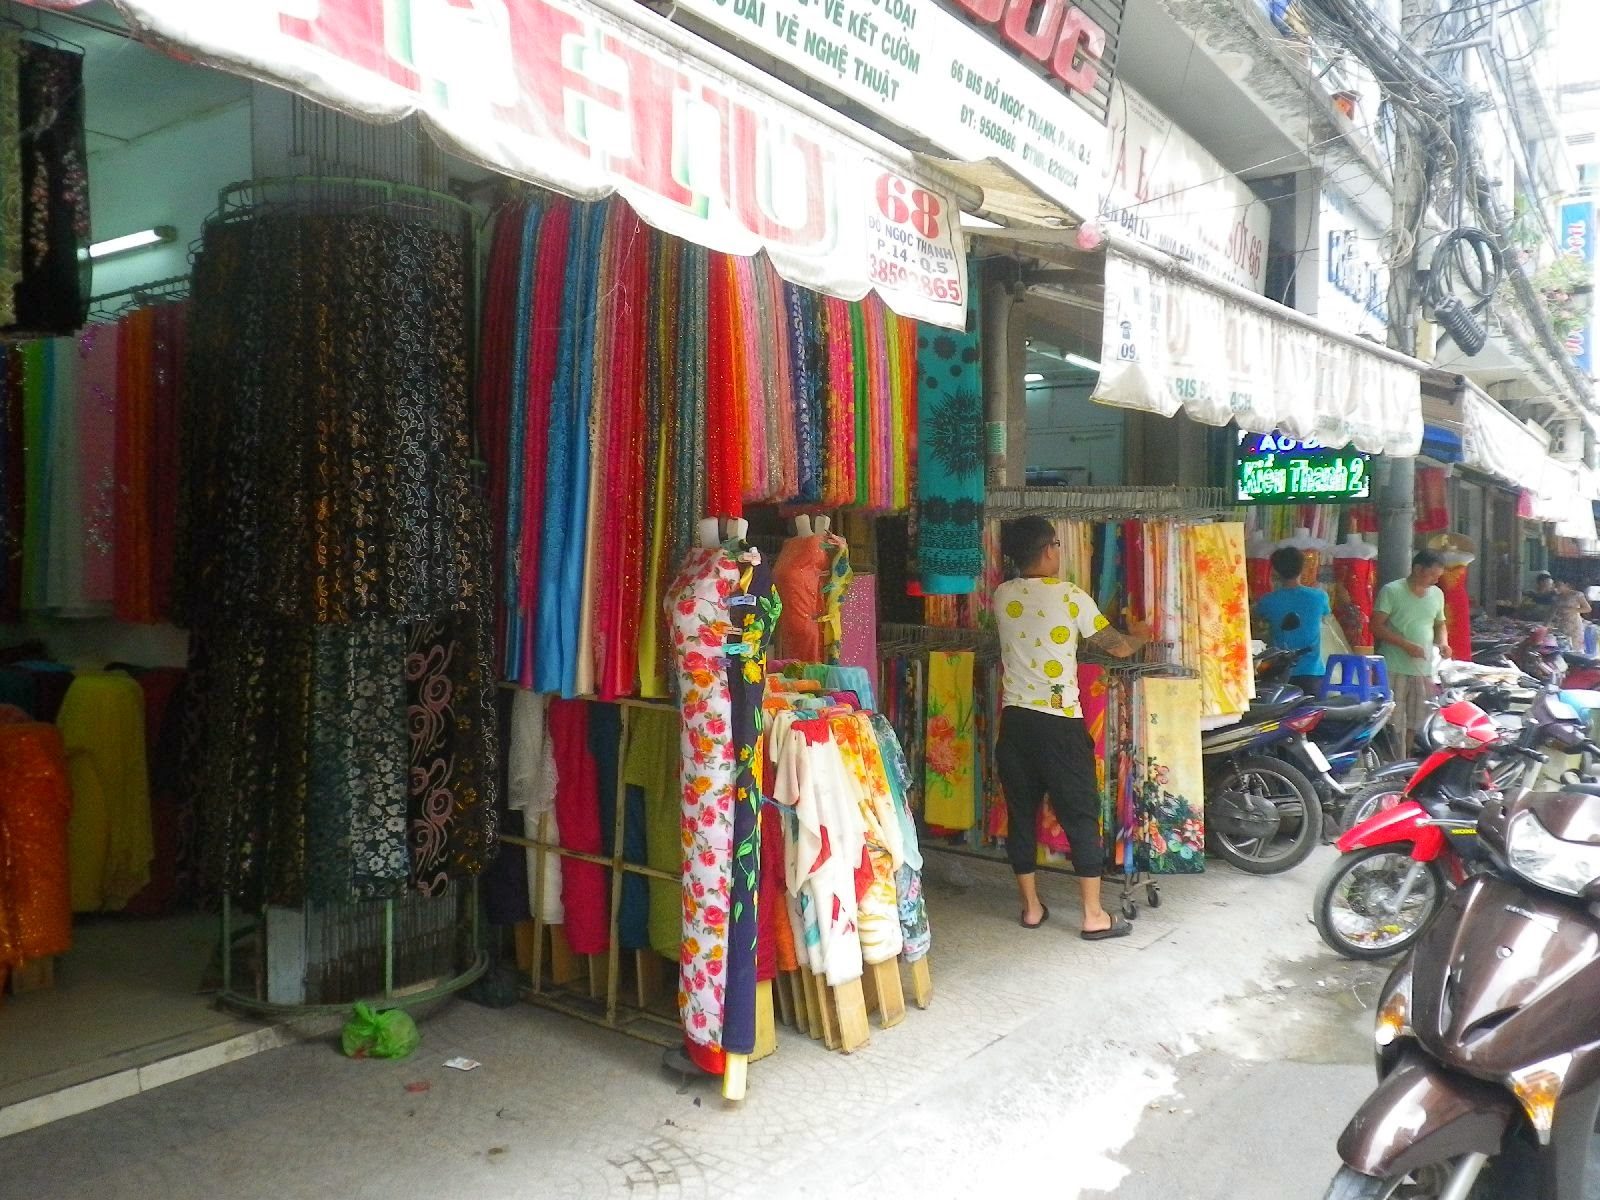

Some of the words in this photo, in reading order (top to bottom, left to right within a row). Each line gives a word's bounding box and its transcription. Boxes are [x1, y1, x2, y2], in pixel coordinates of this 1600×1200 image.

[803, 28, 849, 79] NGHỆ
[853, 57, 900, 102] THUẬT
[848, 10, 878, 46] KẾT
[881, 32, 921, 74] CƯỜM
[950, 58, 965, 83] 66
[965, 68, 983, 96] BIS
[999, 90, 1026, 125] NGỌC
[960, 104, 977, 130] ĐT:
[978, 115, 1017, 153] 9505886
[875, 172, 941, 239] 68
[885, 223, 914, 247] NGỌC
[919, 256, 949, 274] Q.5
[1175, 377, 1197, 398] BIS
[1348, 457, 1364, 491] 2
